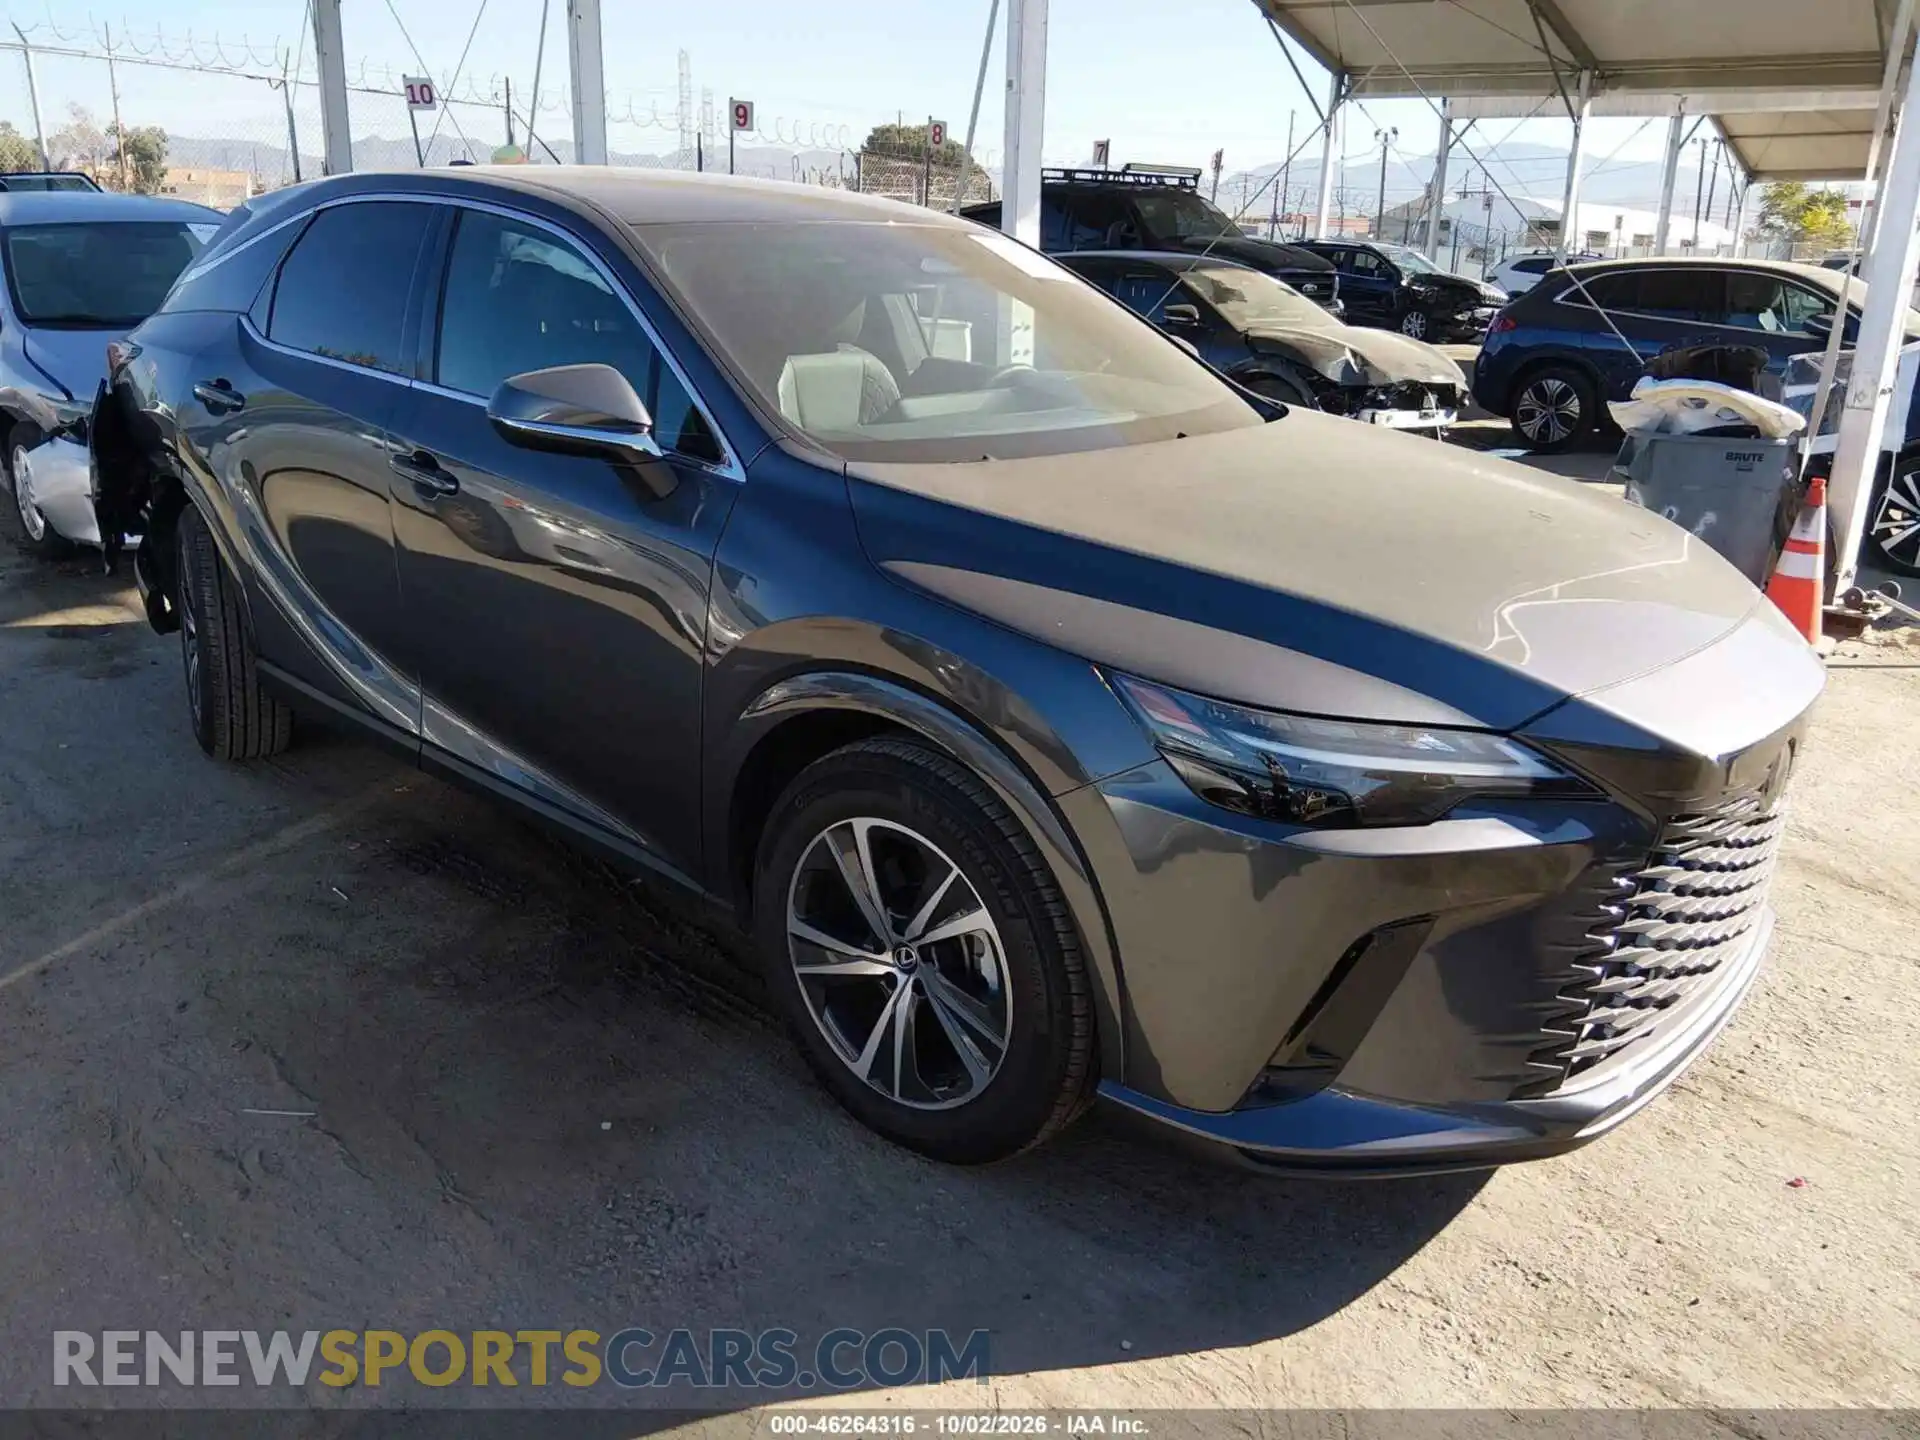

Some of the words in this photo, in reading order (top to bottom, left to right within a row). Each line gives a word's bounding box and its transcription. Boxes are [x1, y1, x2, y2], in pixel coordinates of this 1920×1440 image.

[405, 84, 433, 105] 10
[735, 104, 748, 127] 9
[932, 124, 943, 145] 8
[1097, 143, 1105, 163] 7
[1725, 451, 1765, 462] BRUTE
